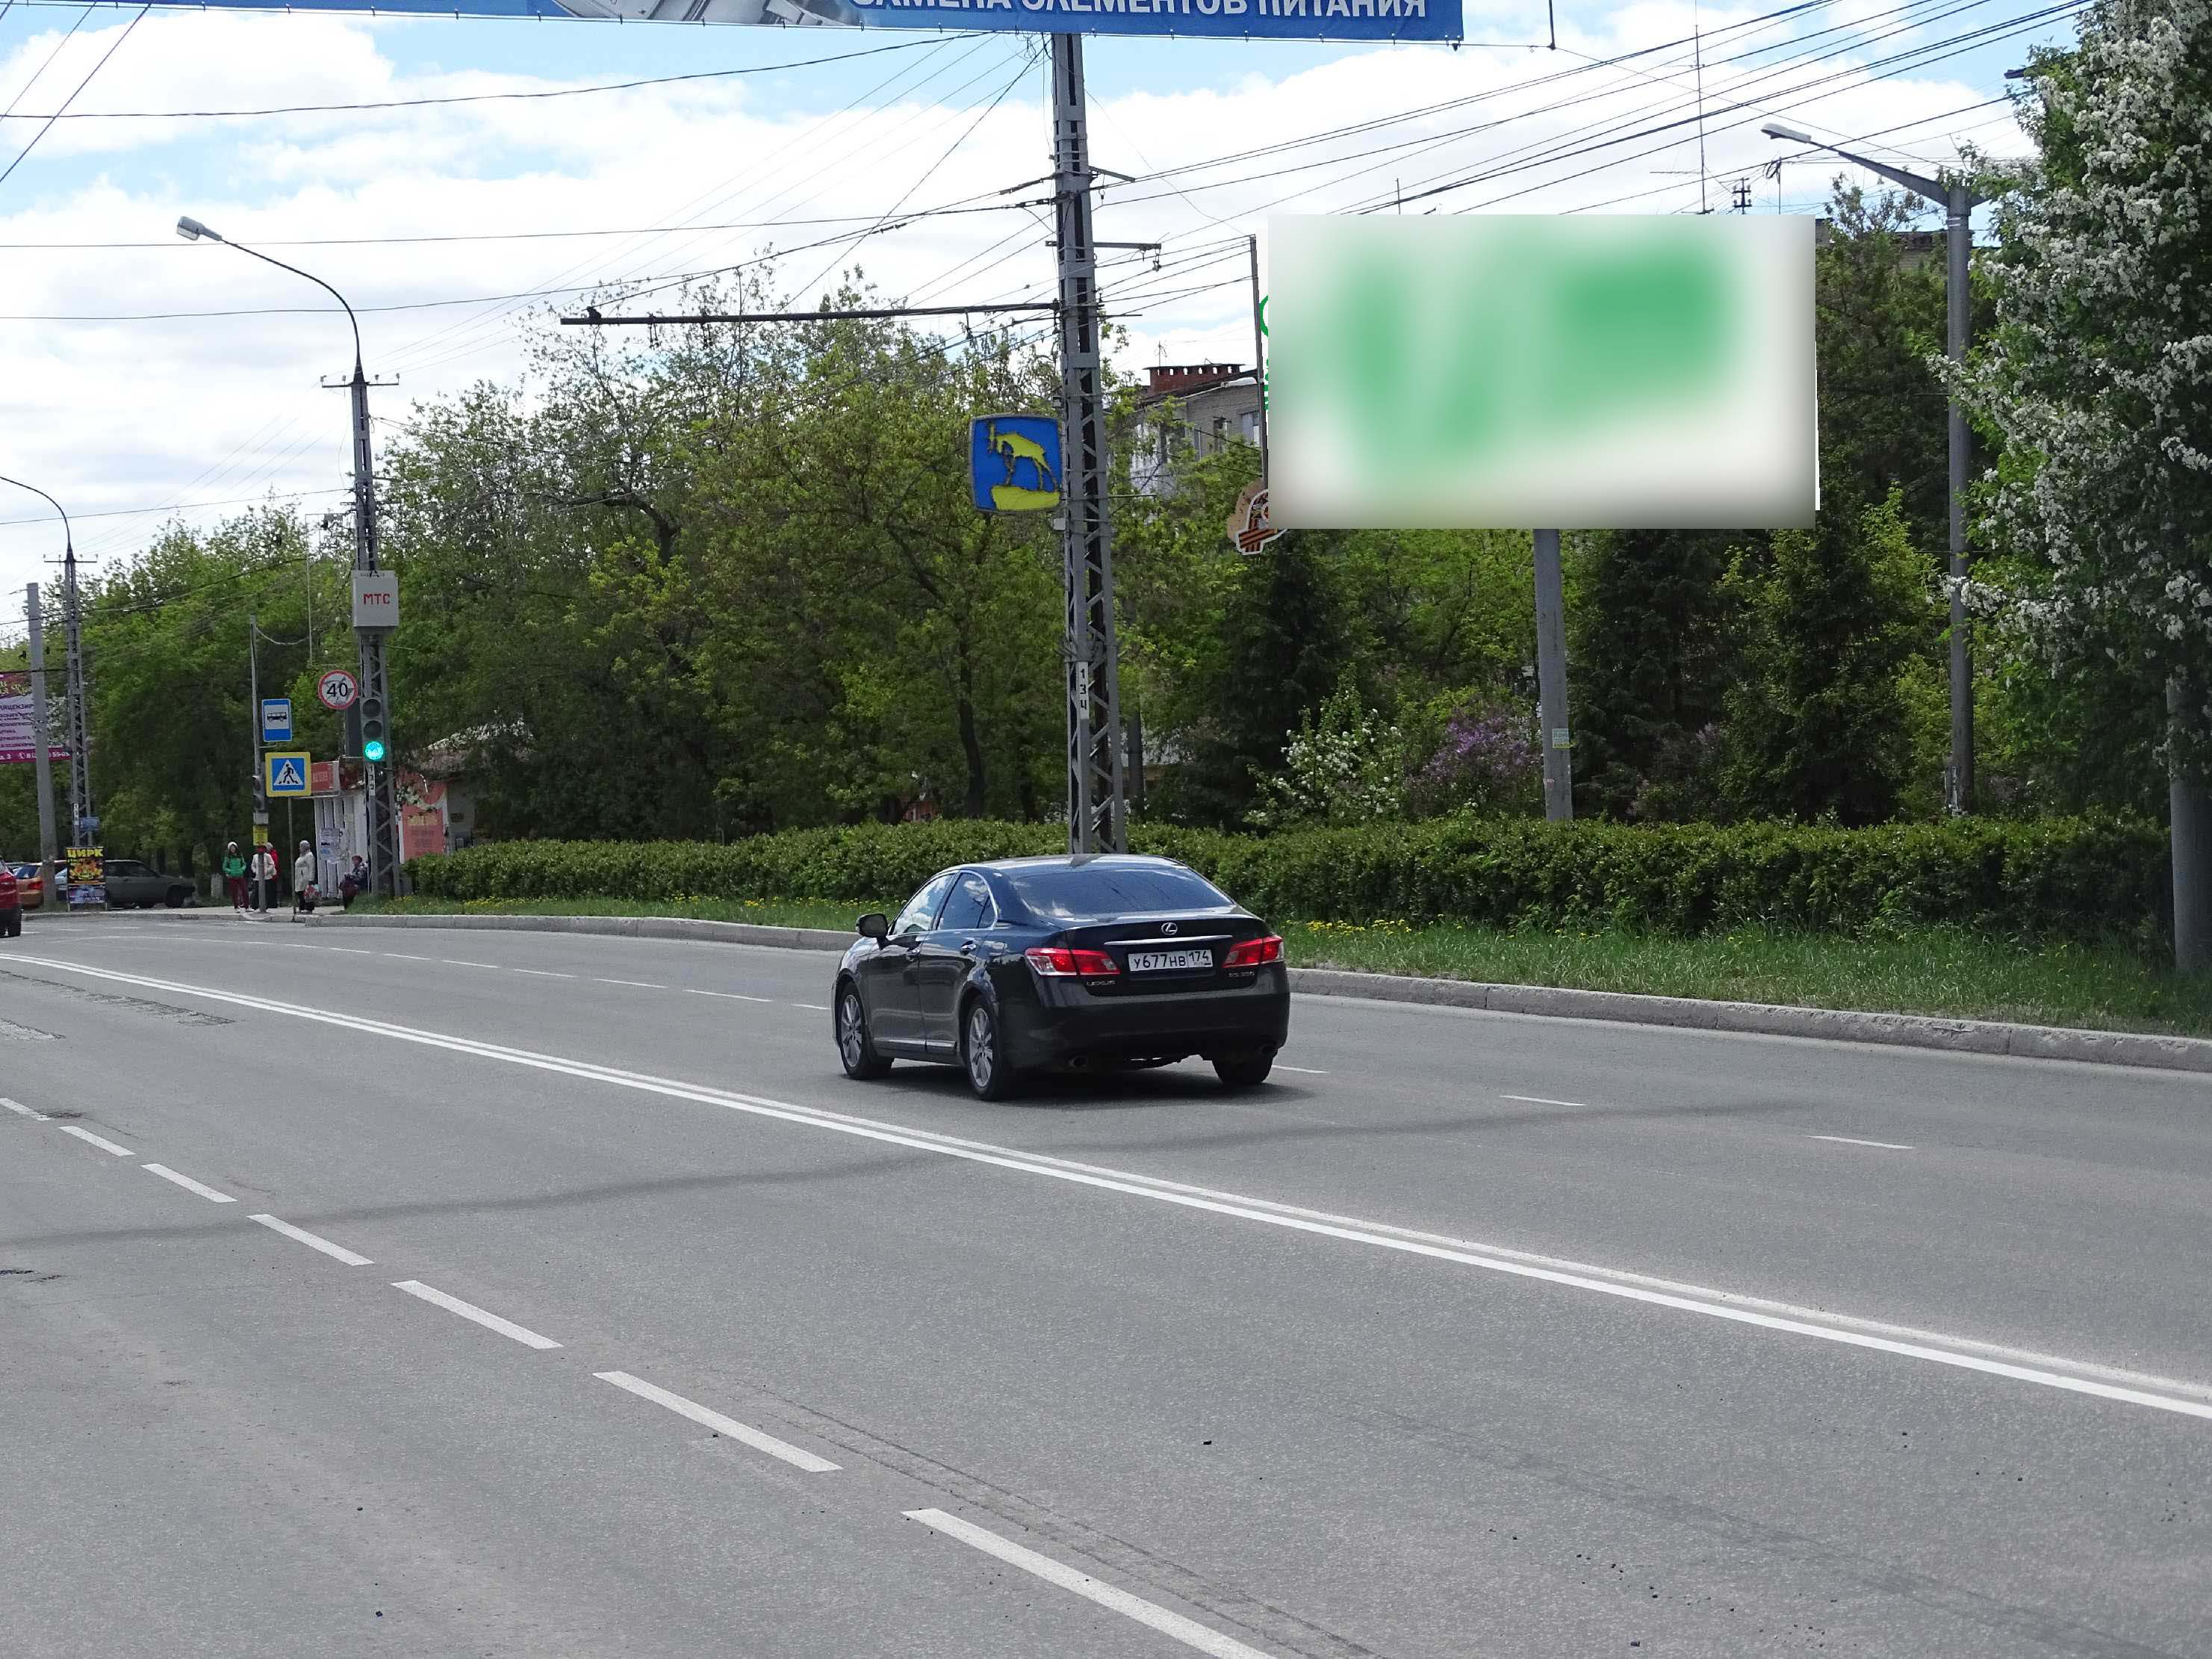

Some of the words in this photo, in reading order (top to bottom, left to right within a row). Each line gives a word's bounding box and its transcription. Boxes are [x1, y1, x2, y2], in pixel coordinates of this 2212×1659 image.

[363, 593, 391, 605] МТС
[326, 683, 349, 697] 40
[67, 848, 104, 858] ЦИРК
[1134, 954, 1186, 969] У677НВ
[1189, 950, 1209, 963] 174
